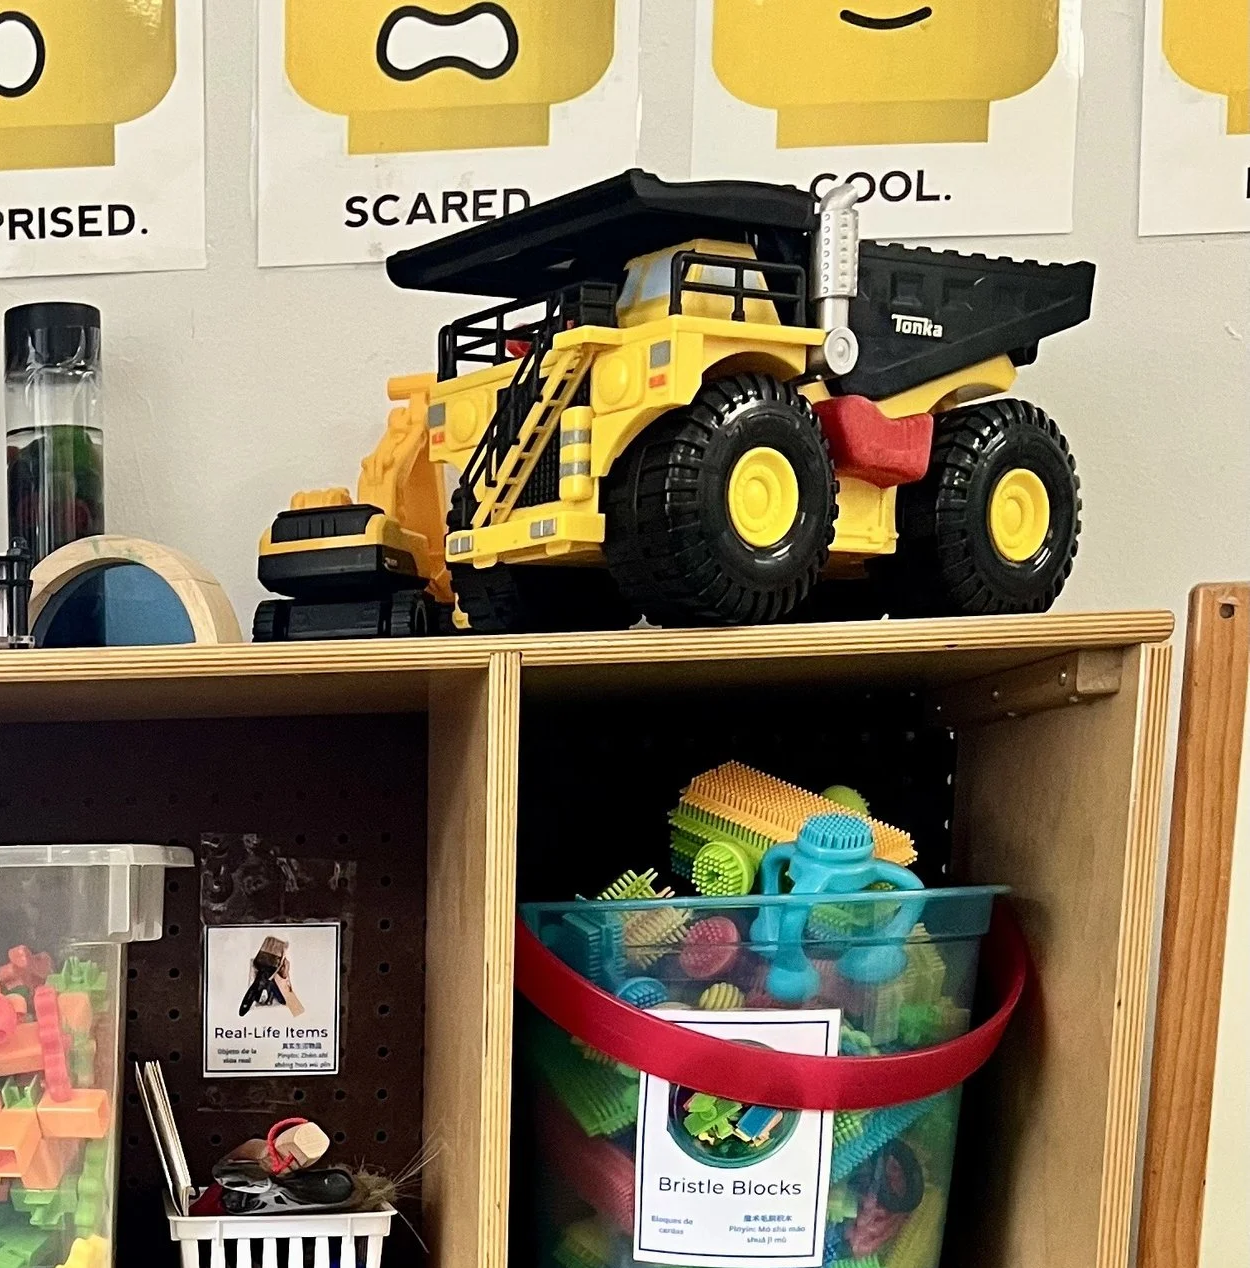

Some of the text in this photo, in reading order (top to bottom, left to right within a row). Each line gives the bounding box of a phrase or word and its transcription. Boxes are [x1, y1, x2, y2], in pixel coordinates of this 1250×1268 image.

[810, 170, 951, 203] COOL.
[891, 314, 943, 338] Tonka
[214, 1026, 328, 1039] Real-Life Items
[659, 1177, 801, 1196] Bristle Blocks
